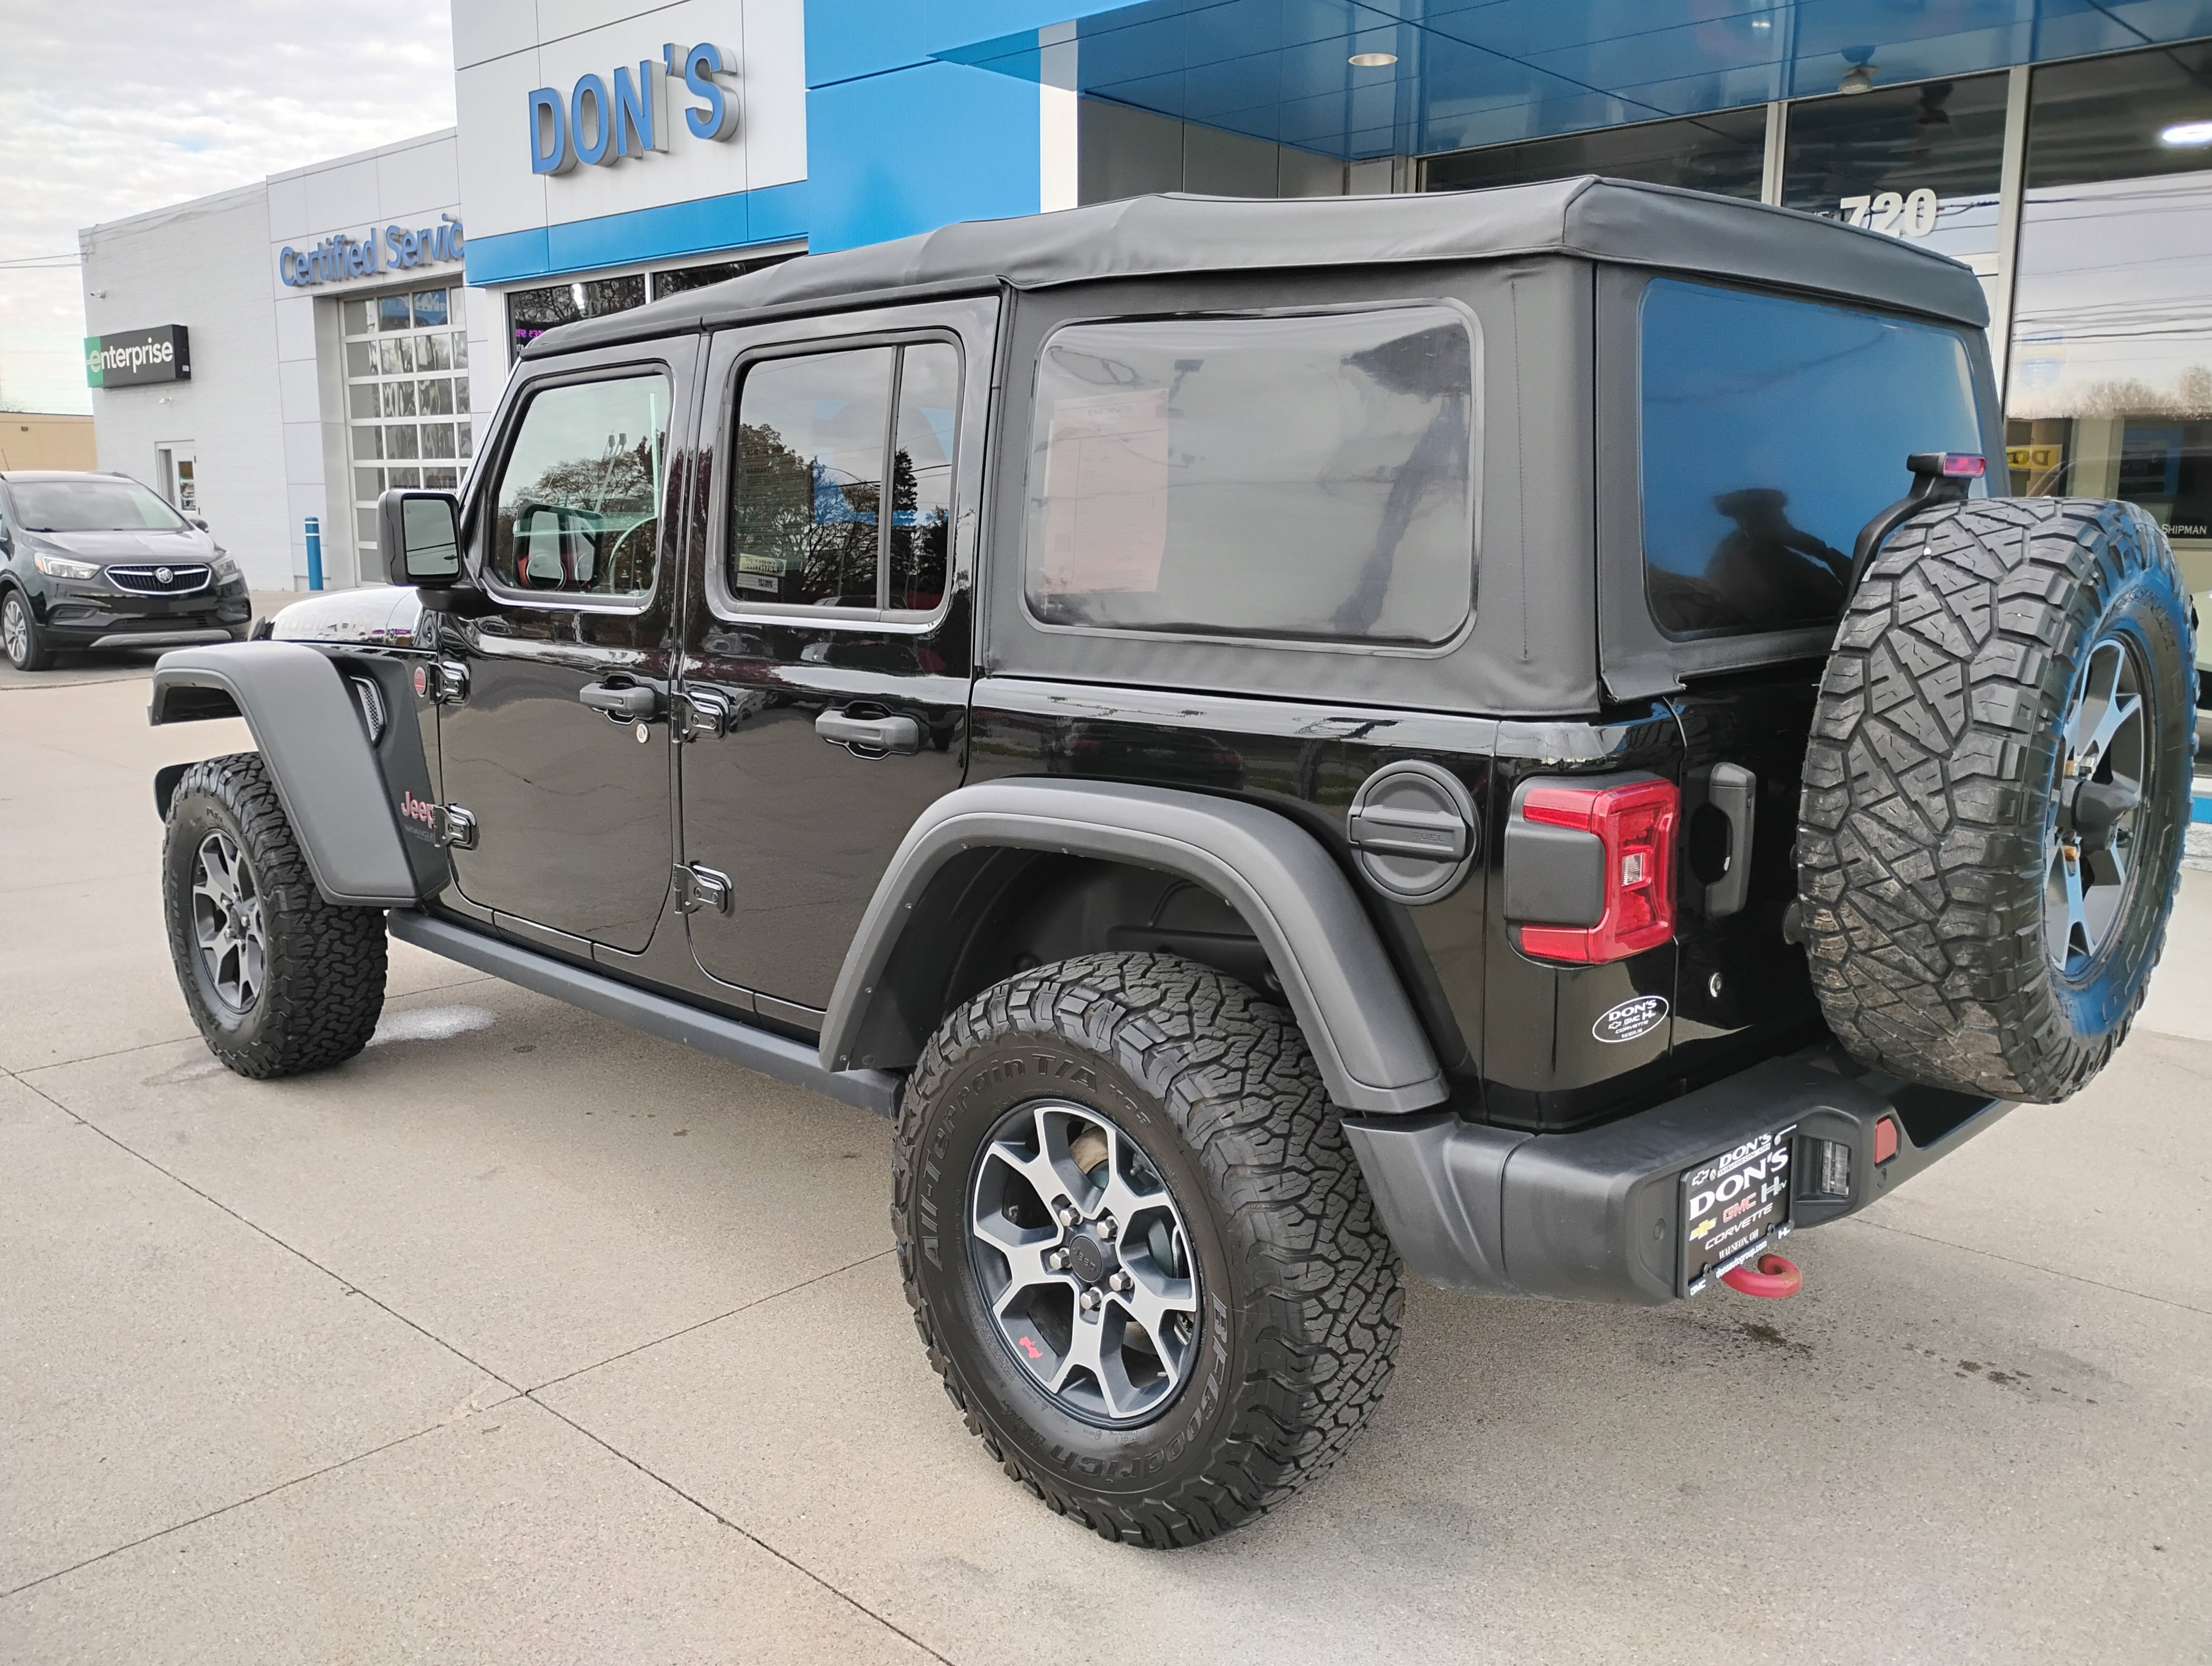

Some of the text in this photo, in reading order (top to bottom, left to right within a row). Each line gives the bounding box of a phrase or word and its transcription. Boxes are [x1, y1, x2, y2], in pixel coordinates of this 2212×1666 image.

[529, 42, 736, 175] DON'S
[1840, 188, 1937, 238] 720
[280, 213, 465, 286] Certified Servic
[86, 337, 173, 373] enterprise
[2162, 524, 2207, 535] SHIPMAN
[401, 791, 434, 829] Jeep
[403, 824, 434, 838] WRANGLE
[1412, 831, 1445, 843] FUEL
[1609, 999, 1657, 1022] DON'S
[1615, 1020, 1649, 1034] CORVETTE
[1624, 1015, 1641, 1025] GMC
[921, 1058, 1026, 1272] All-Terrain
[1032, 1053, 1097, 1093] T/A
[1719, 1132, 1772, 1169] DON'S
[1758, 1145, 1771, 1153] OH
[1689, 1147, 1789, 1221] DON'S
[1722, 1192, 1757, 1223] GMC
[1705, 1202, 1773, 1250] CORVETTE
[1715, 1240, 1767, 1278] donsautogroup.com
[1719, 1235, 1749, 1259] WAUSEON,
[1689, 1279, 1706, 1296] GMC
[1050, 1292, 1229, 1484] BFGoodrich
